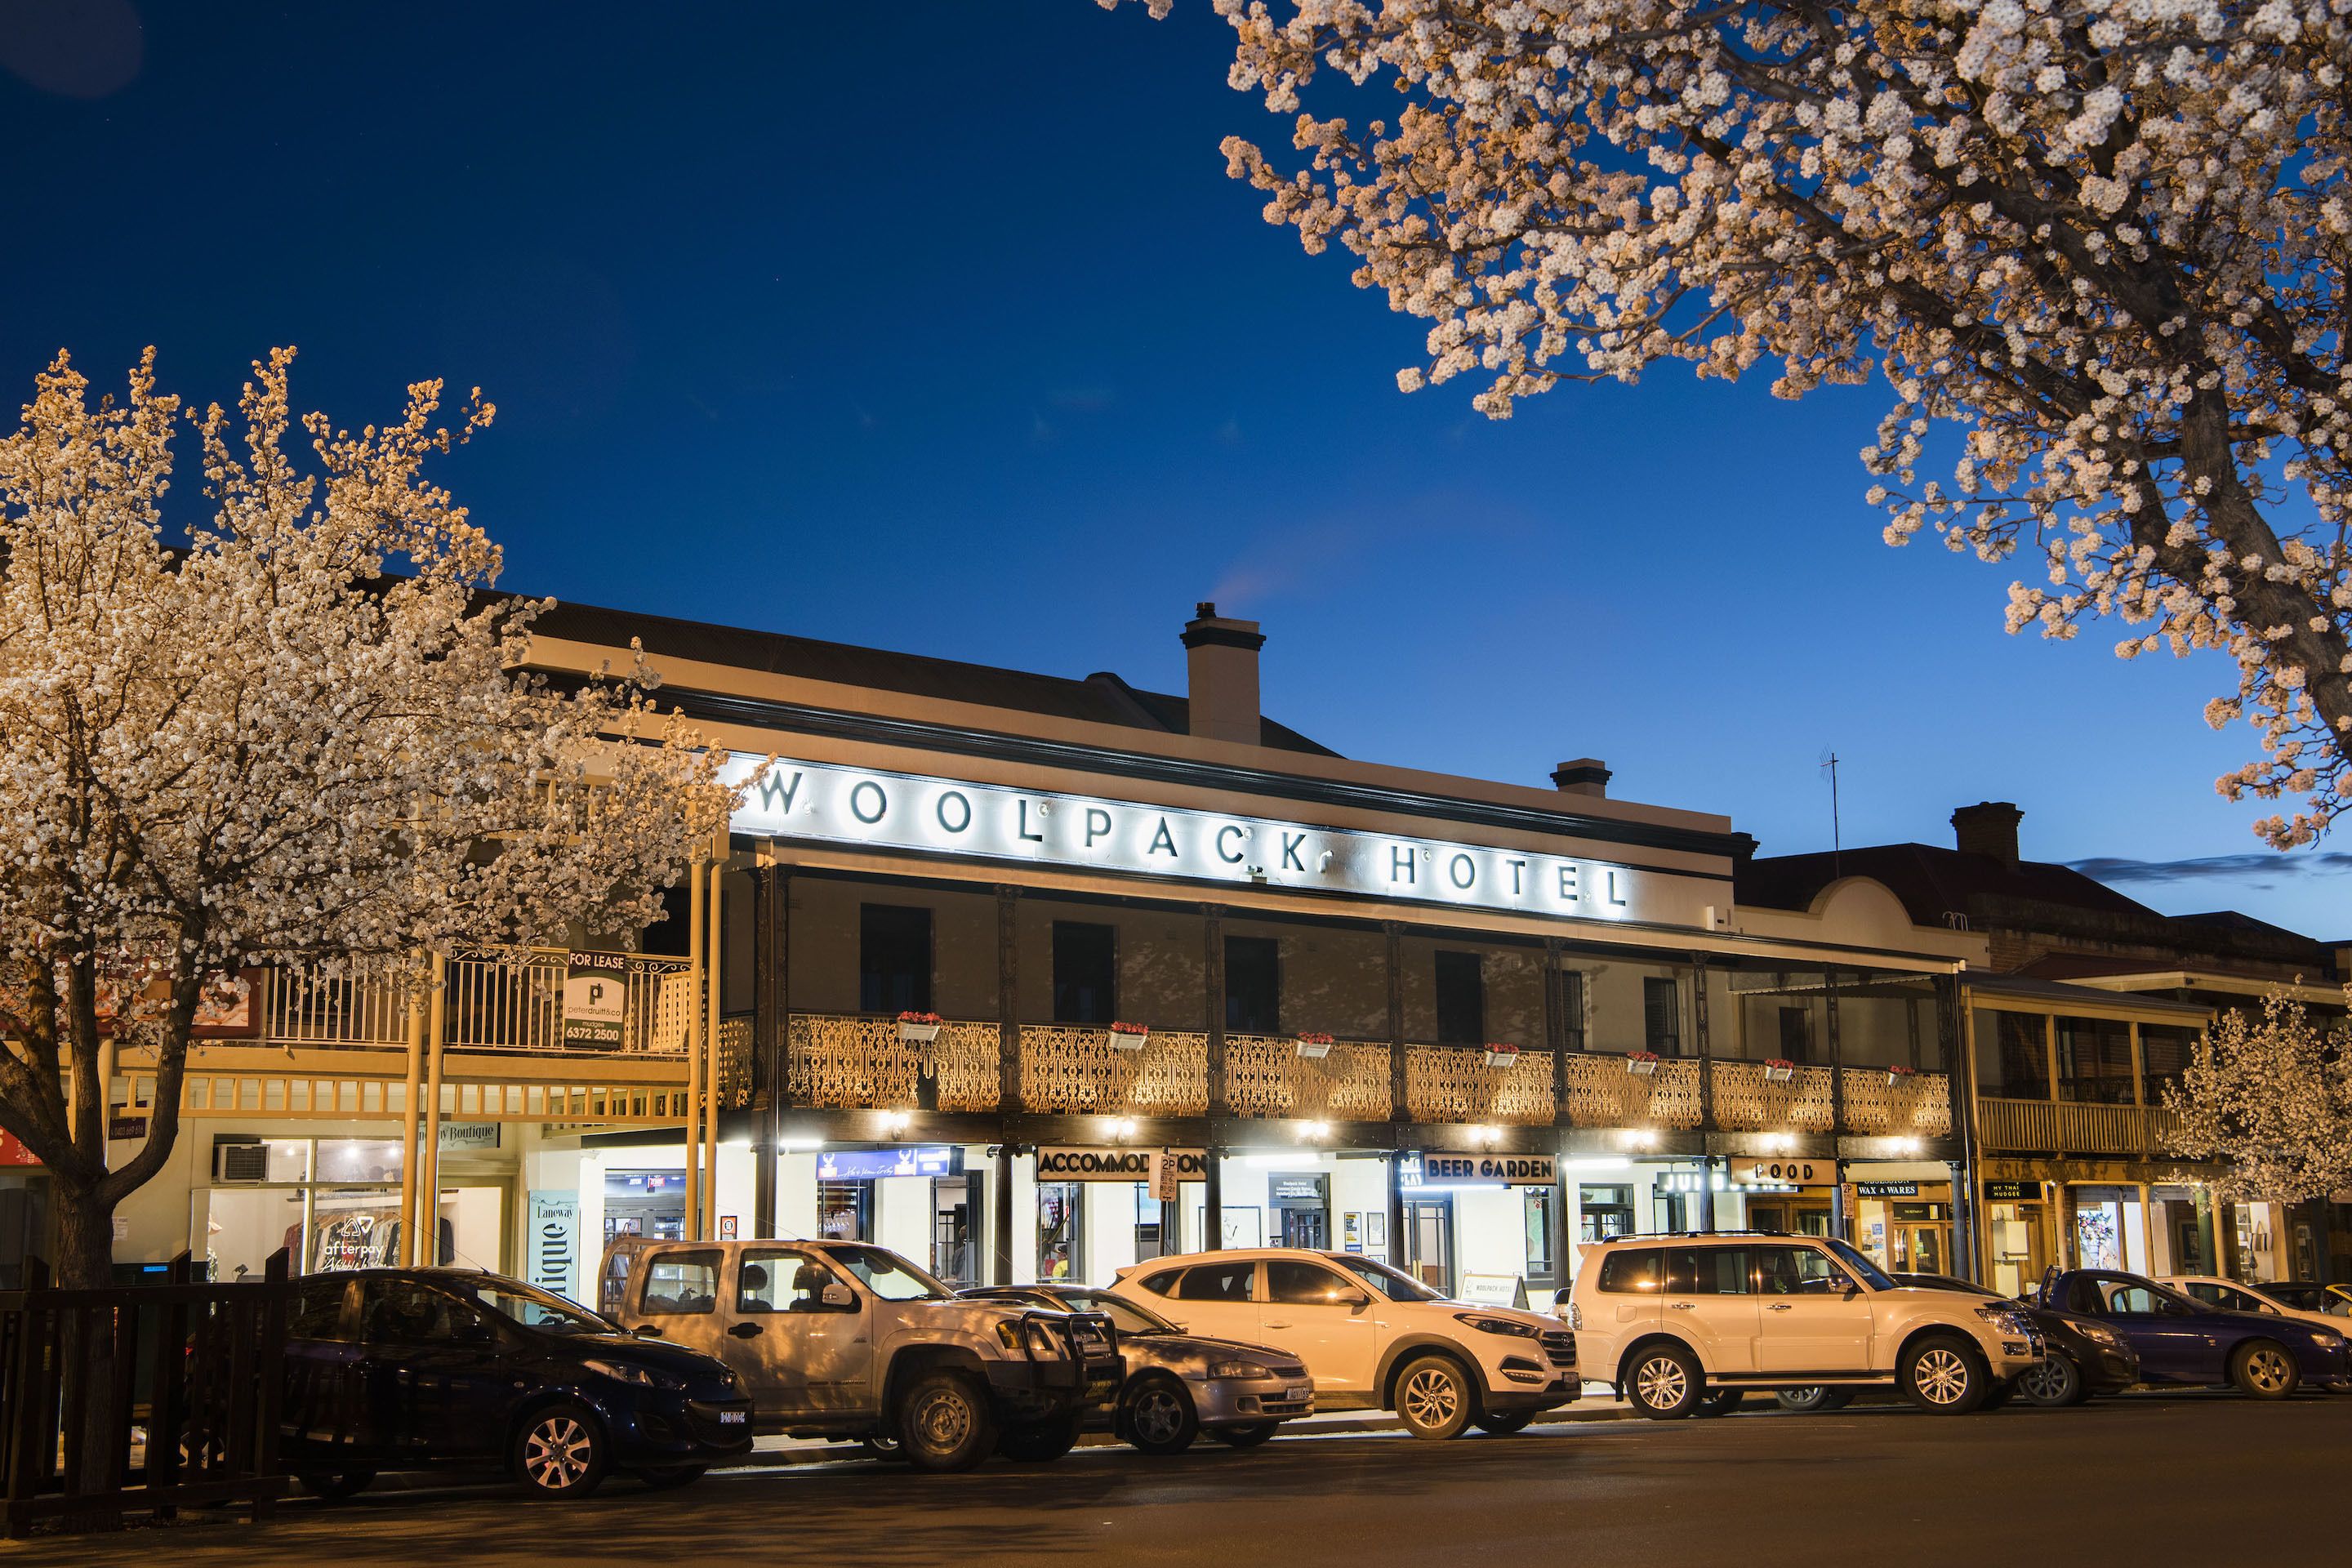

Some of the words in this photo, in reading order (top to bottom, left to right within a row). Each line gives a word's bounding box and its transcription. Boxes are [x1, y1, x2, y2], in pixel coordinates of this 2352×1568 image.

[759, 770, 1307, 872] WOOLPACK
[1391, 846, 1626, 906] HOTEL
[570, 953, 590, 966] FOR
[594, 955, 624, 969] LEASE
[567, 1027, 591, 1039] 6372
[595, 1029, 619, 1041] 2500
[450, 1125, 493, 1141] Boutique
[1039, 1152, 1207, 1173] ACCOMMODION
[1162, 1159, 1174, 1169] 2P
[1429, 1160, 1473, 1177] BEER
[1481, 1160, 1552, 1178] GARDEN
[1756, 1163, 1813, 1179] FOOD
[1842, 1184, 1851, 1193] 2P
[1859, 1187, 1877, 1195] WAX
[1887, 1186, 1915, 1194] WARES
[537, 1206, 573, 1219] Laneway
[324, 1241, 383, 1258] afterpay
